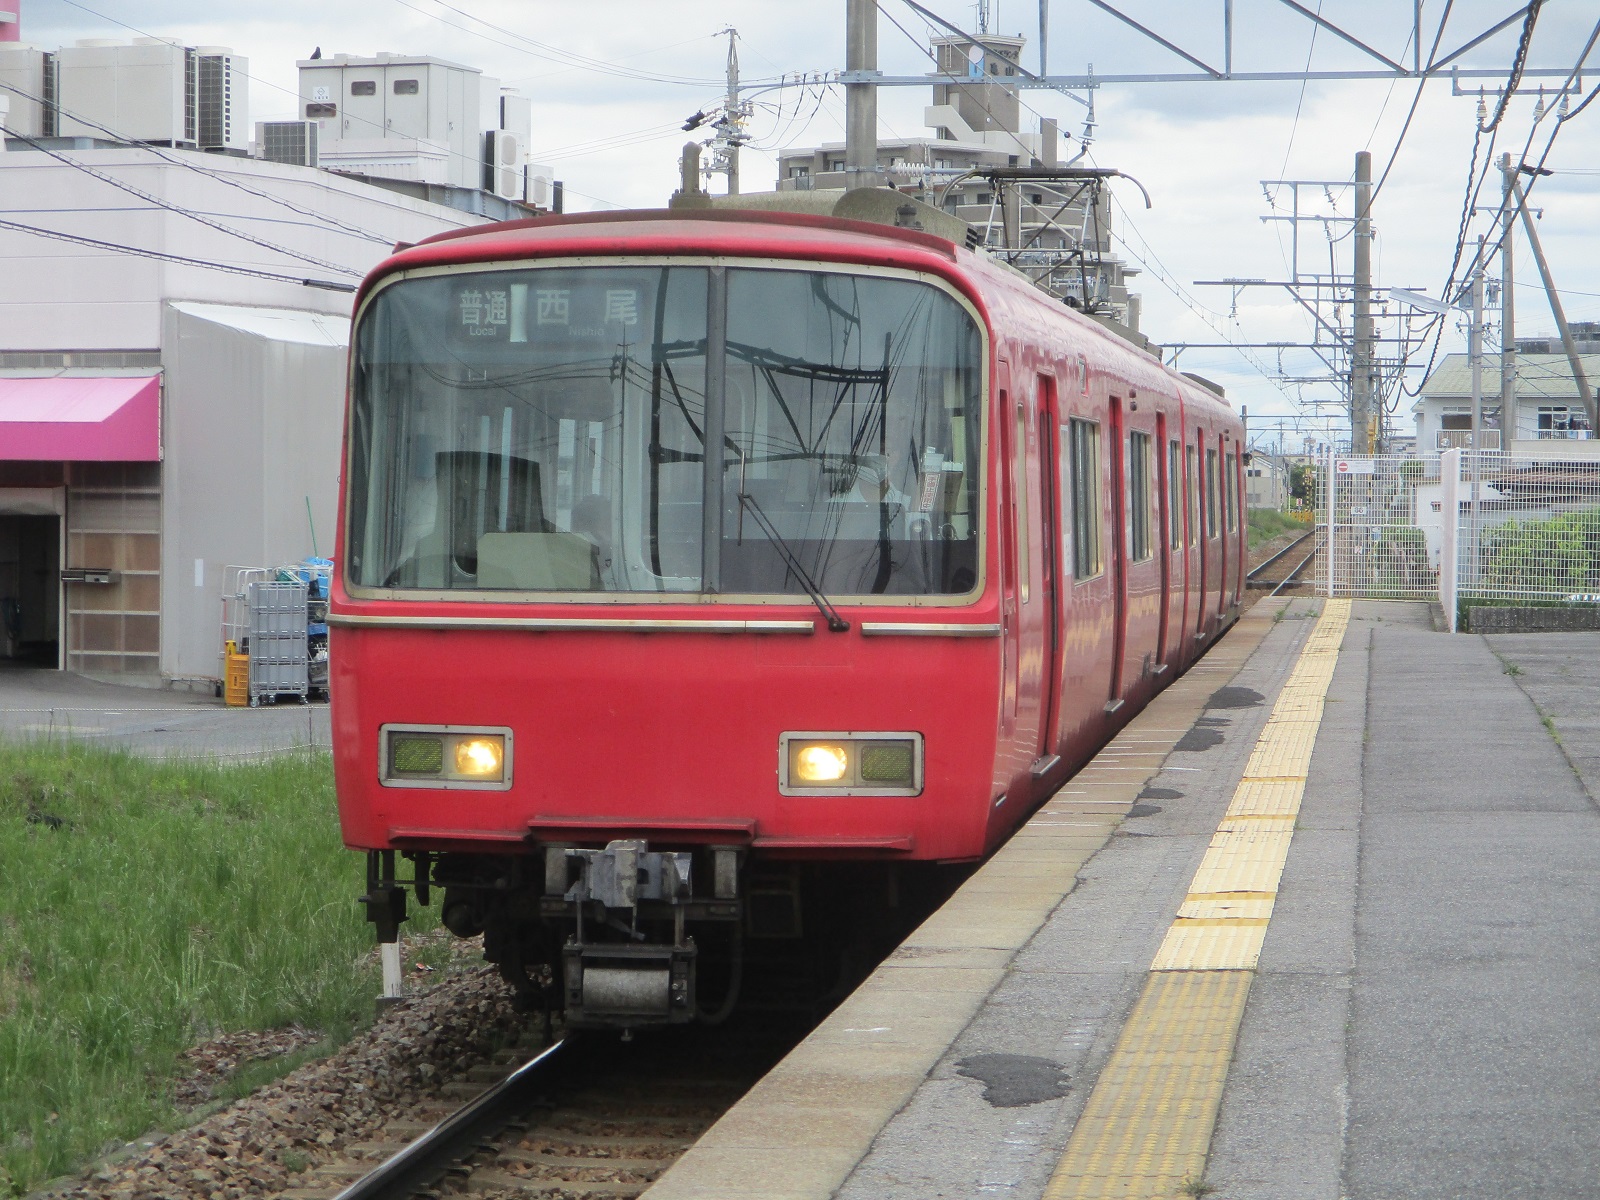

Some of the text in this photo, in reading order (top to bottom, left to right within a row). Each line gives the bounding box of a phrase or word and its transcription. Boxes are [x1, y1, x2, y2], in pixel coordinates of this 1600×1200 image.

[460, 289, 638, 325] 普通 西尾
[469, 325, 497, 337] Local
